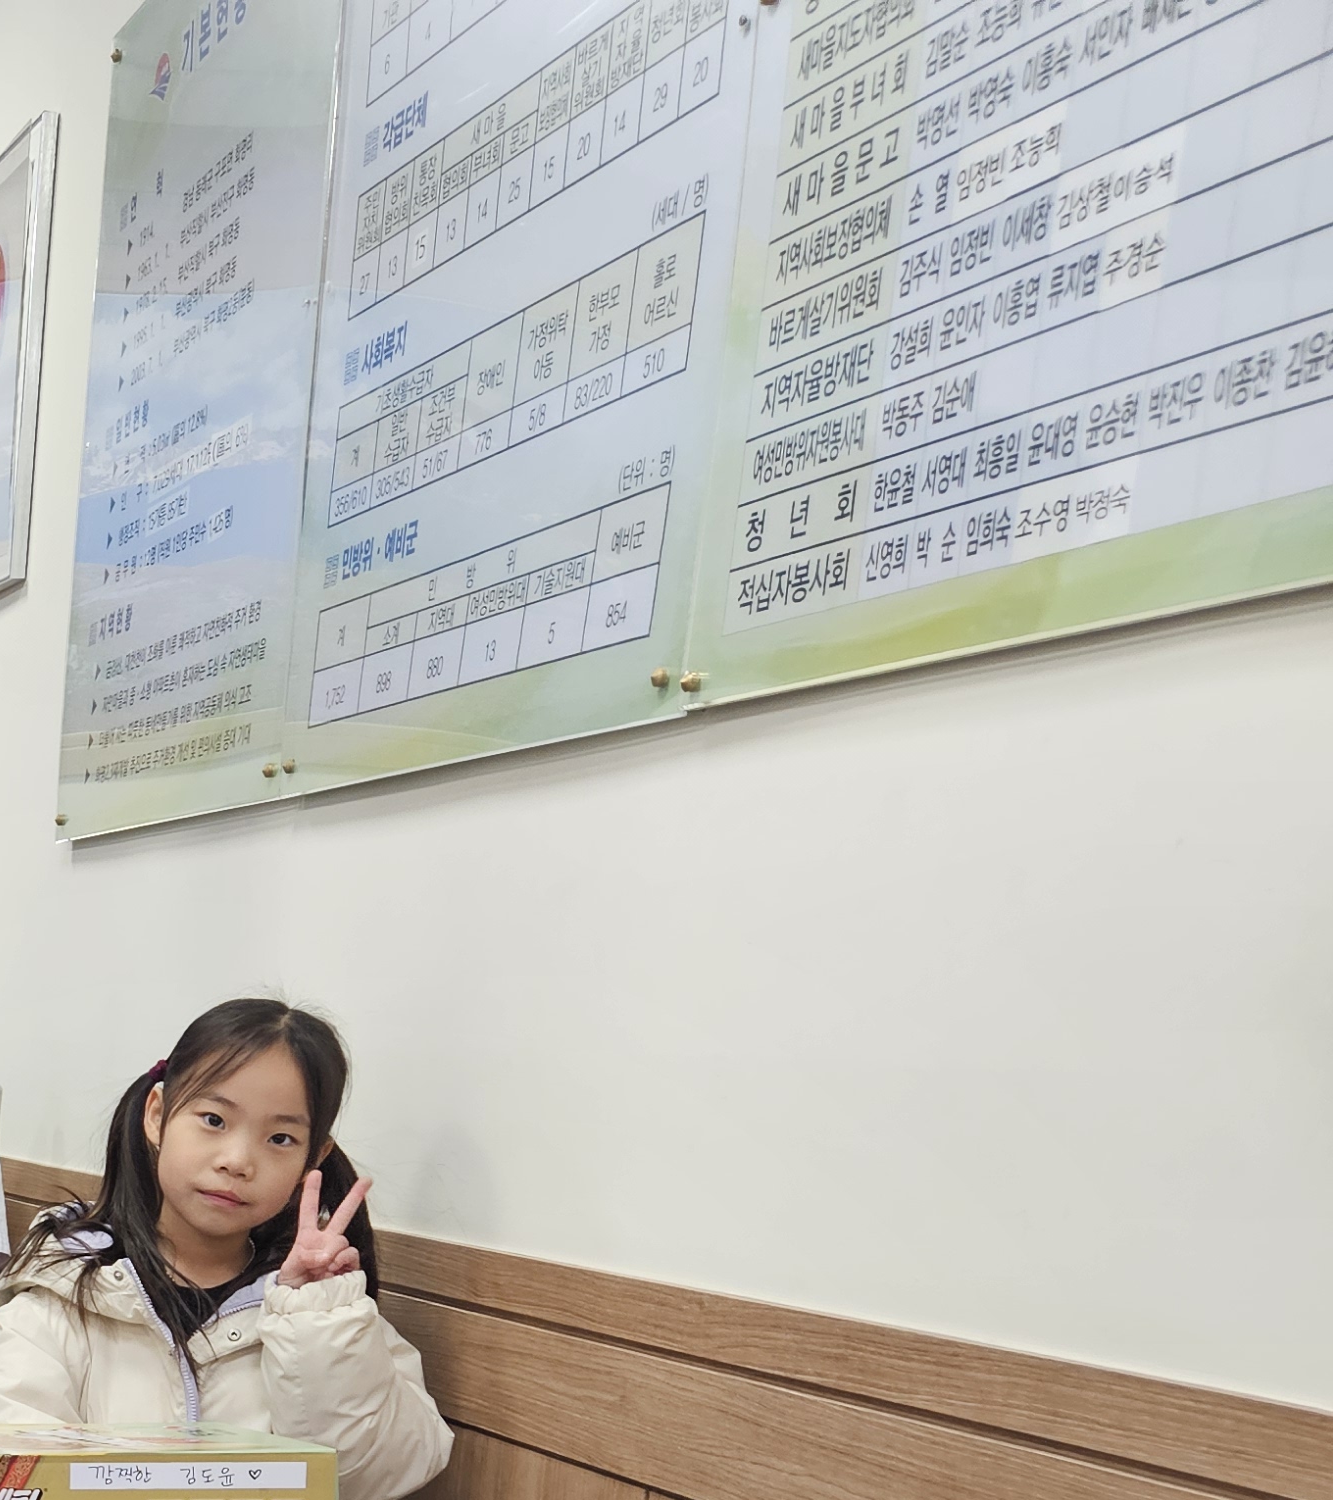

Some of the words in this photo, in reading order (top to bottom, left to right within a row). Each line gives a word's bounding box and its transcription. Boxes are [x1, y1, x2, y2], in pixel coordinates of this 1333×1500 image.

[692, 56, 710, 87] 20
[652, 82, 670, 113] 29
[381, 90, 429, 153] 각급단체
[507, 176, 522, 205] 25
[477, 197, 489, 224] 14
[414, 234, 427, 262] 15
[775, 193, 895, 286] 지역사회보장협의체
[359, 272, 372, 296] 27
[588, 284, 622, 323] 한부모
[643, 287, 680, 328] 어르신
[767, 266, 885, 353] 바르게살기위원회
[360, 319, 409, 375] 사회복지
[527, 309, 570, 352] 가정위탁
[589, 321, 613, 355] 가정
[476, 358, 507, 397] 장애인
[533, 350, 555, 383] 아동
[642, 347, 666, 380] 510
[760, 337, 876, 418] 지역자율방재단
[573, 372, 615, 411] 83/220
[474, 428, 493, 457] 776
[421, 449, 450, 480] 51/67
[341, 536, 374, 581] 민방위
[384, 519, 420, 564] 예비군
[610, 520, 647, 556] 예비군
[737, 547, 852, 616] 적십자봉사회
[604, 600, 629, 629] 854
[483, 639, 497, 664] 13
